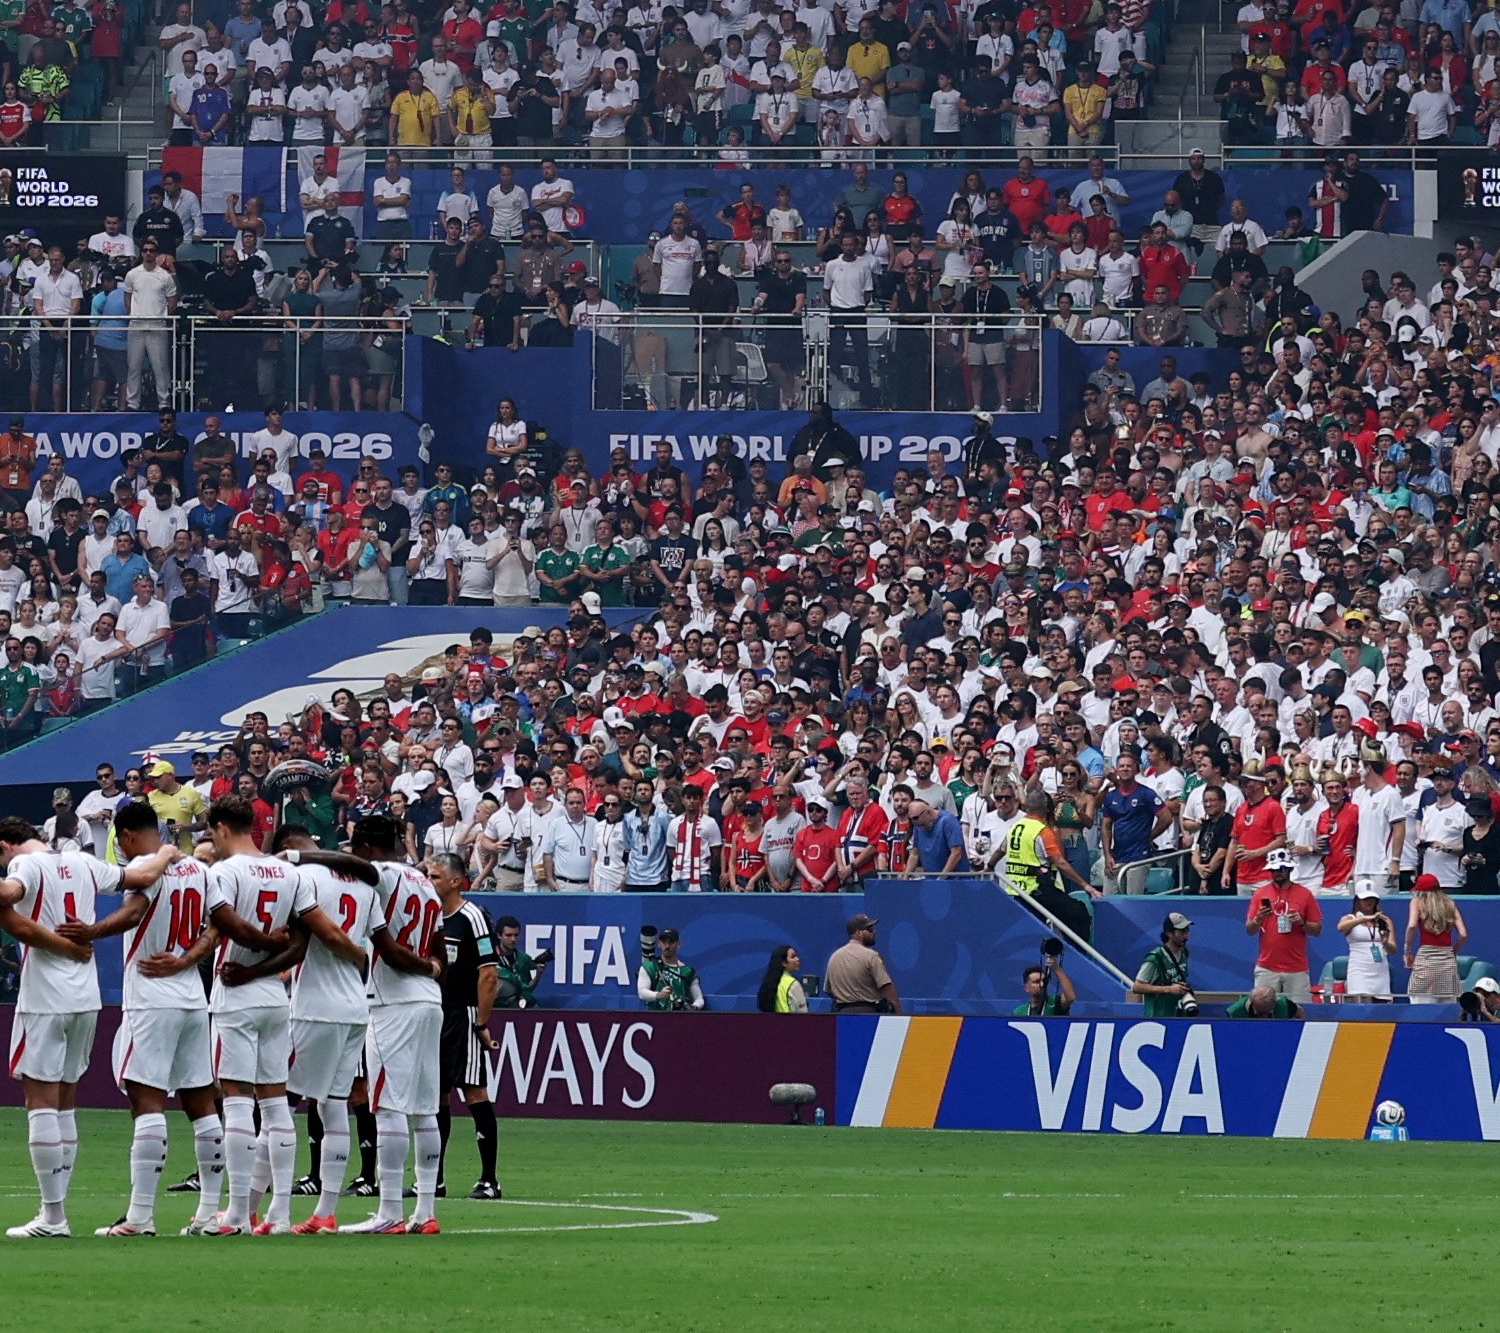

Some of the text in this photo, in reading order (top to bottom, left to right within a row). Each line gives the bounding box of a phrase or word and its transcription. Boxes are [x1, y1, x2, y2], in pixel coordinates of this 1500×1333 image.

[16, 168, 48, 179] FIFA
[16, 181, 69, 193] WORLD
[16, 194, 99, 207] CUP 2026
[297, 433, 394, 461] 026
[165, 888, 202, 952] 10
[256, 890, 278, 935] 5
[394, 894, 442, 960] 20
[525, 925, 630, 986] FIFA
[478, 1021, 656, 1110] WAYS
[1008, 1021, 1225, 1133] VISA
